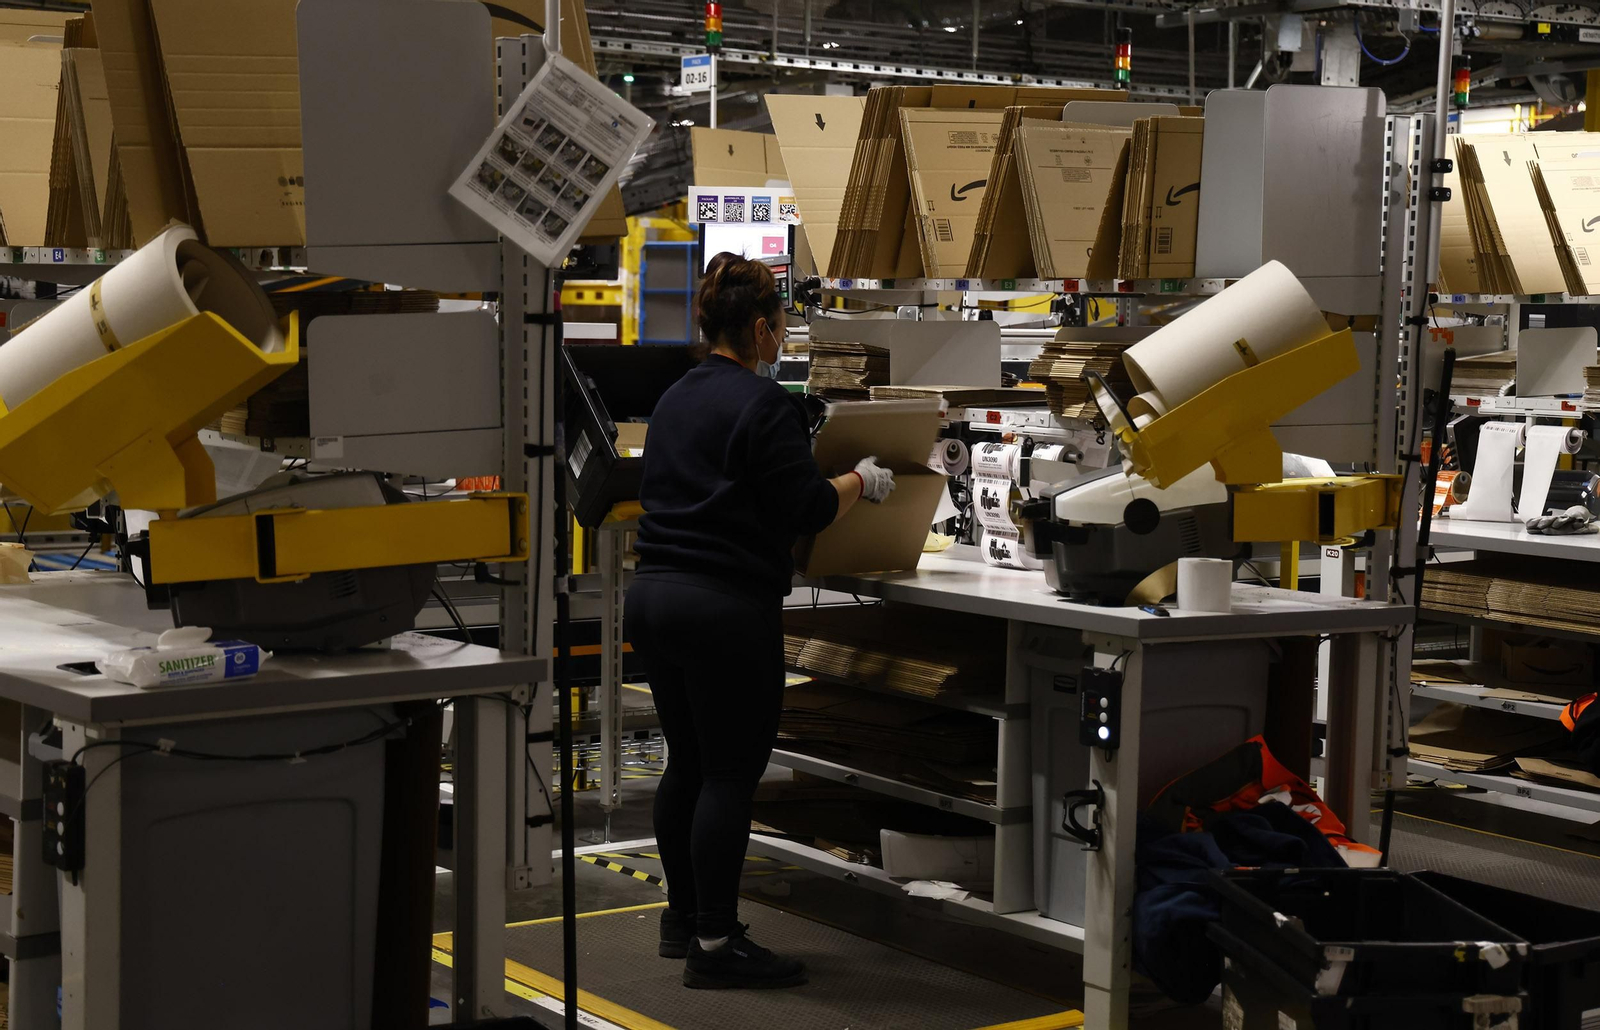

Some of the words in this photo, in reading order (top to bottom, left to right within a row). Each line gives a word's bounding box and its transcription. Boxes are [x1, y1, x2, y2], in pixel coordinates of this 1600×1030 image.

[685, 71, 708, 84] 02-16
[842, 280, 850, 288] E6
[990, 413, 998, 421] C2
[981, 456, 999, 464] UN3090
[159, 655, 215, 673] SANITIZER
